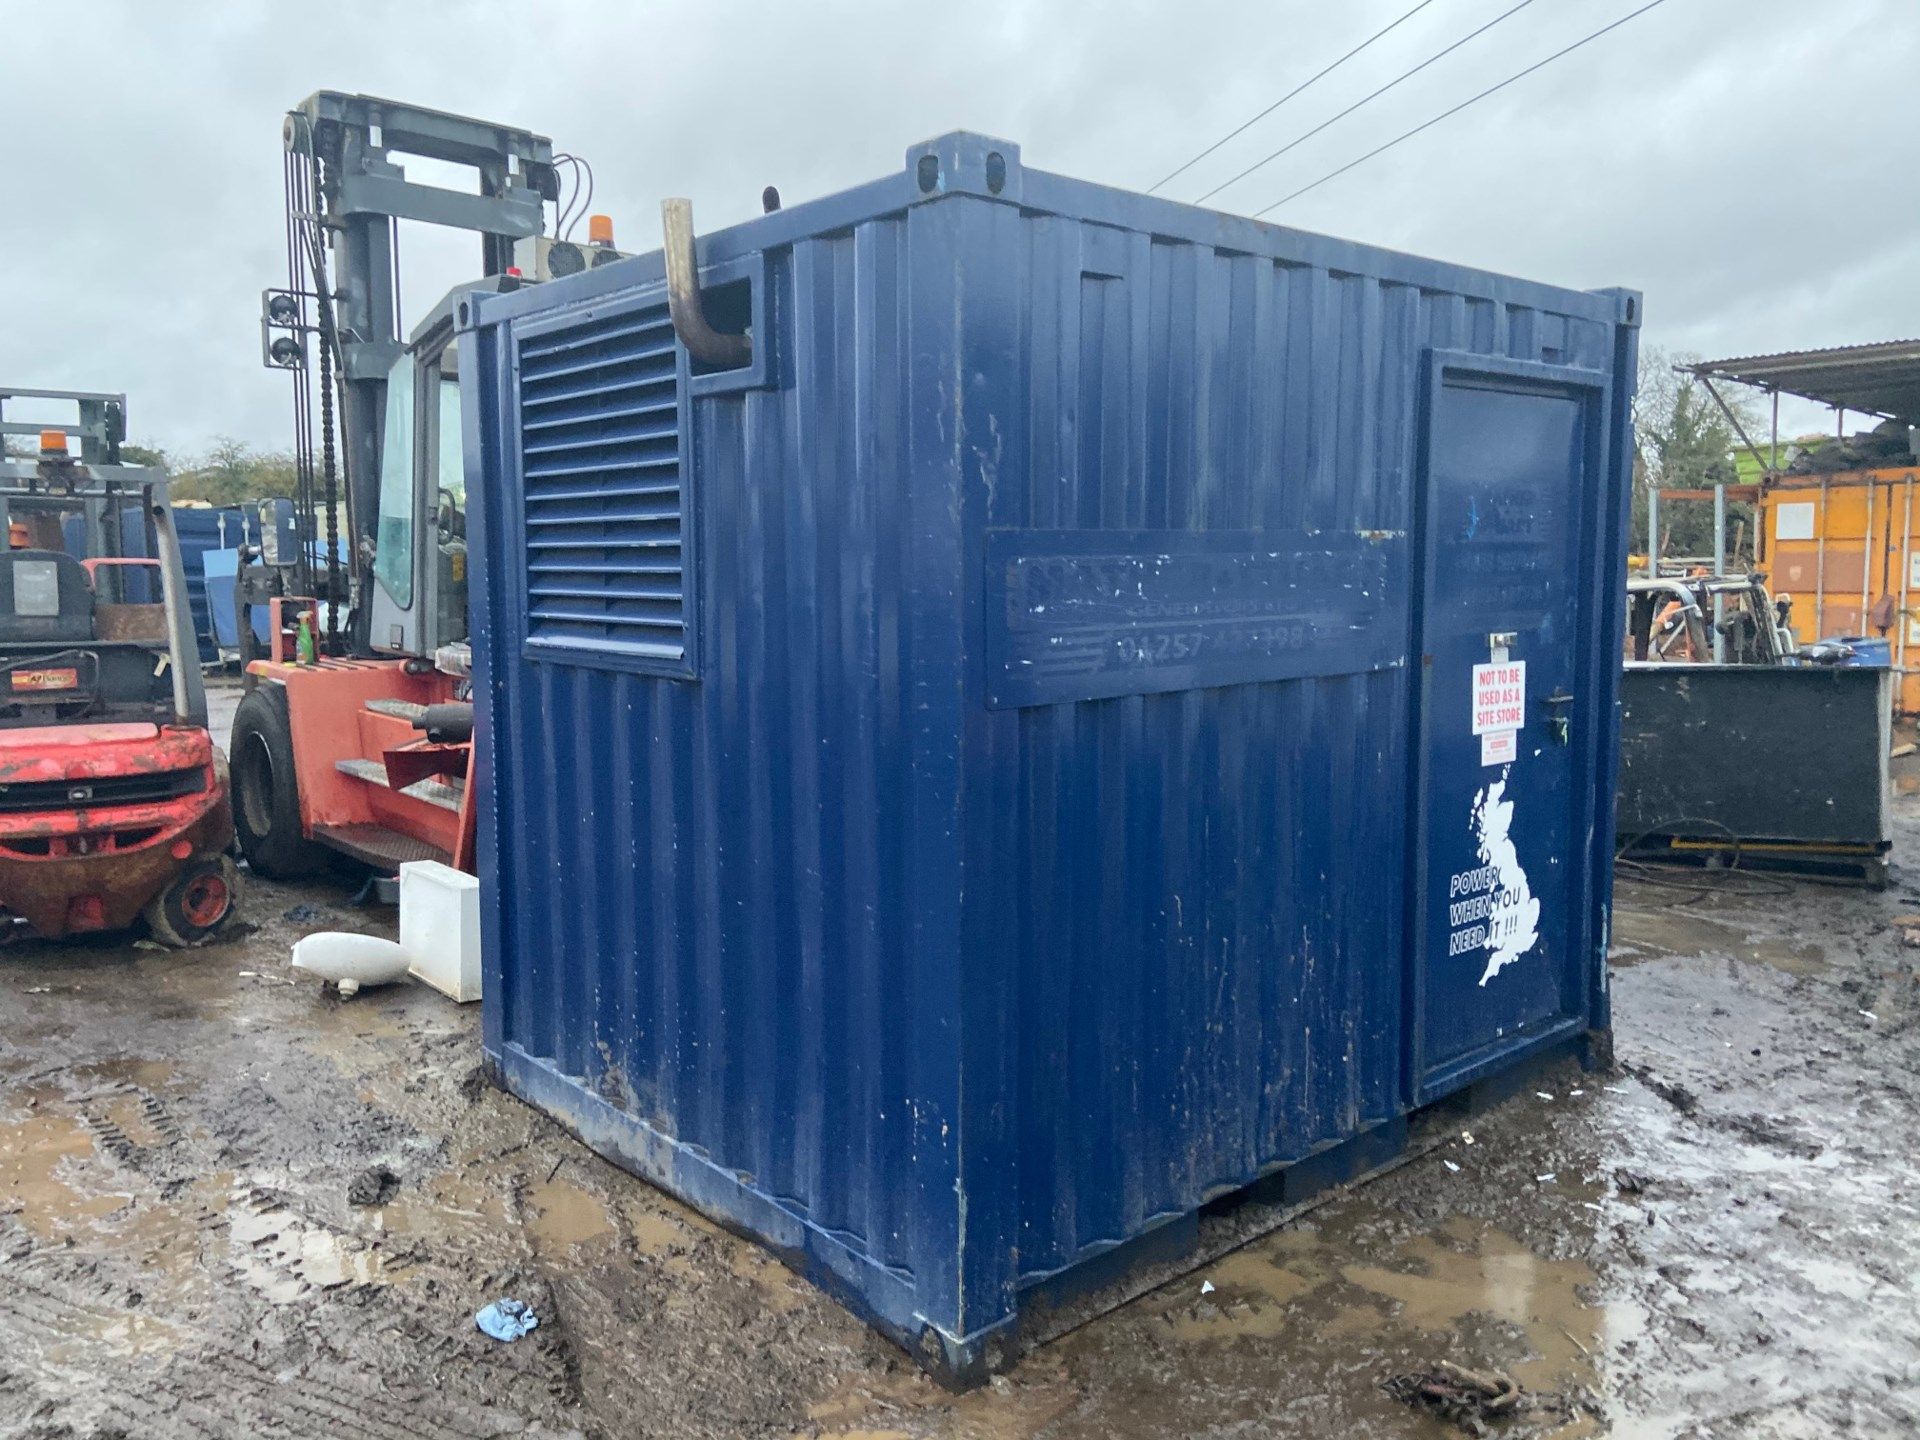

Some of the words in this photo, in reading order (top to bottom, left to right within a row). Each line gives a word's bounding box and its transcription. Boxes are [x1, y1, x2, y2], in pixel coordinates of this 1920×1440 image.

[1479, 670, 1496, 687] NOT
[1497, 669, 1508, 685] TO
[1509, 668, 1520, 684] BE
[1478, 690, 1501, 706] USED
[1502, 688, 1513, 704] AS
[1514, 688, 1521, 702] A
[1477, 710, 1495, 727] SITE
[1496, 707, 1522, 724] STORE
[1450, 865, 1499, 898] POWER
[1449, 893, 1492, 927] WHEN
[1494, 886, 1521, 911] YOU
[1449, 924, 1486, 957] NEED
[1488, 919, 1501, 941] IT
